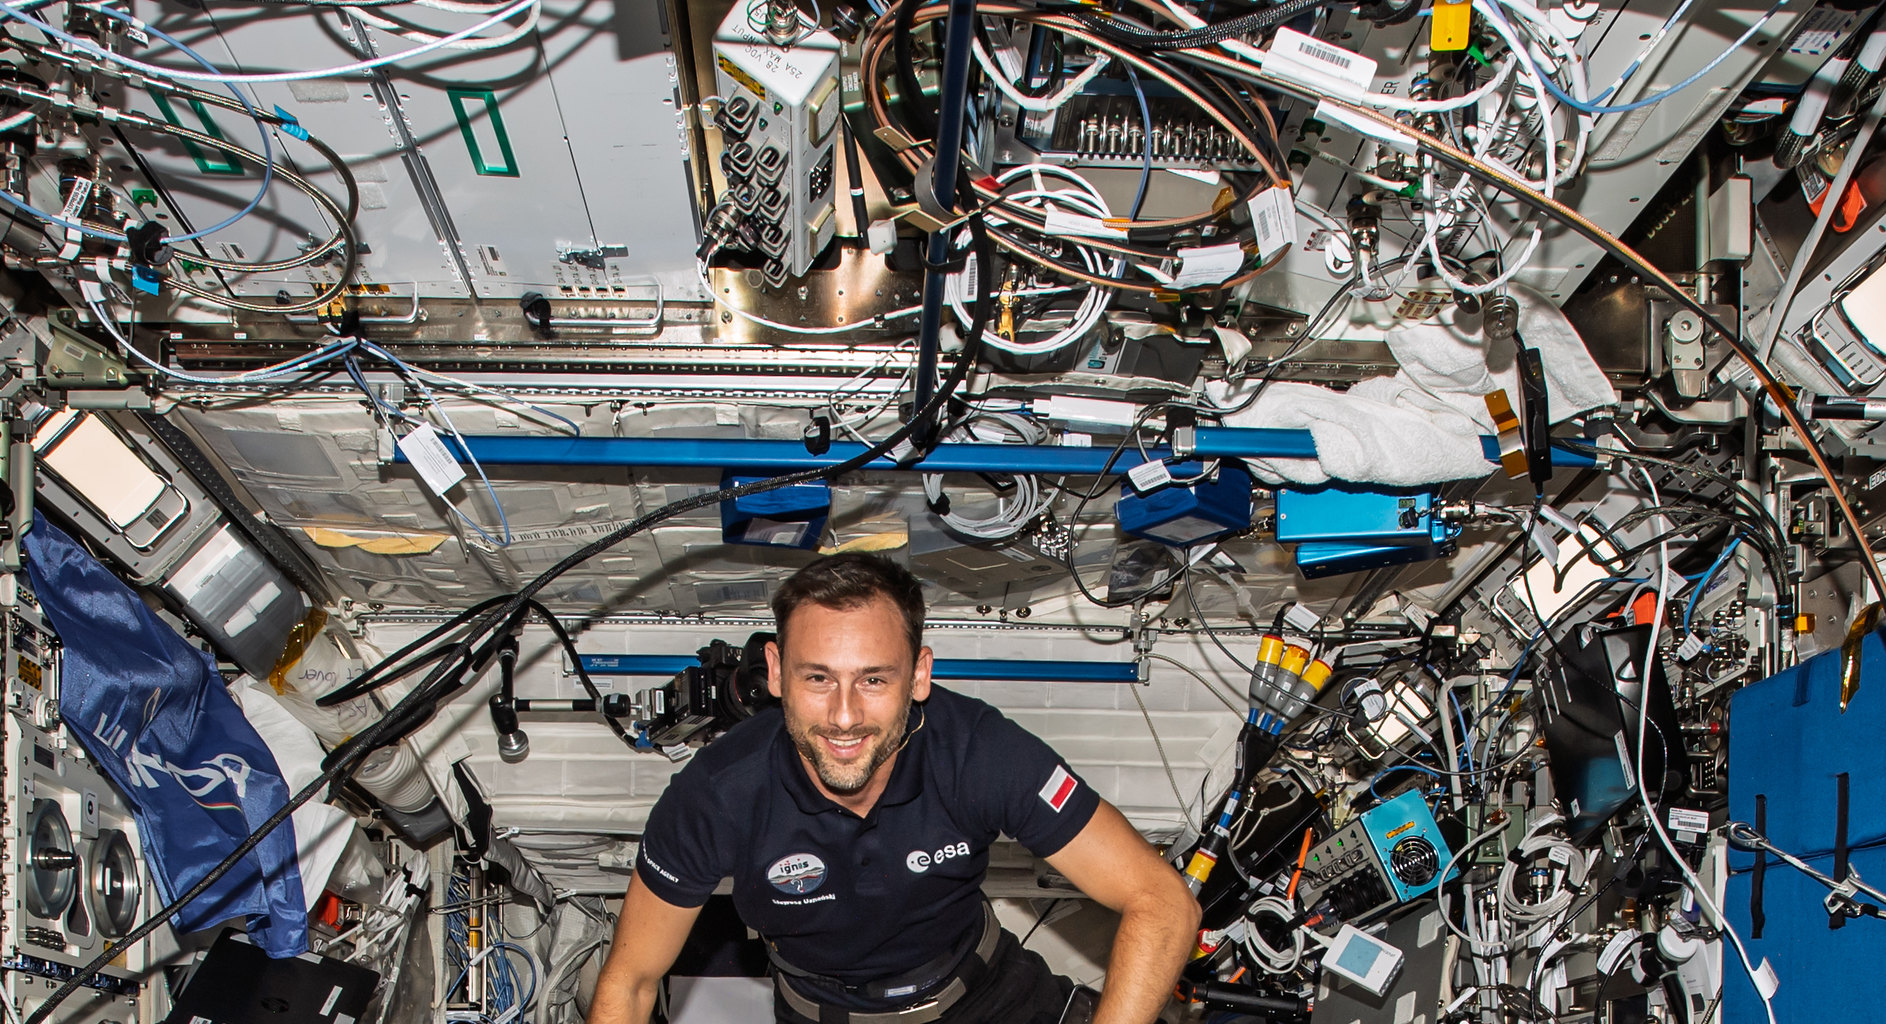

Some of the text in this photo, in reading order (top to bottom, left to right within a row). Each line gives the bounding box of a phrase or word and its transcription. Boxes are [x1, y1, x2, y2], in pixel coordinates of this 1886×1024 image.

[732, 22, 803, 79] 25A MAX INPUT
[744, 46, 779, 73] 28 VDC
[933, 841, 971, 865] esa
[780, 860, 809, 875] ignis
